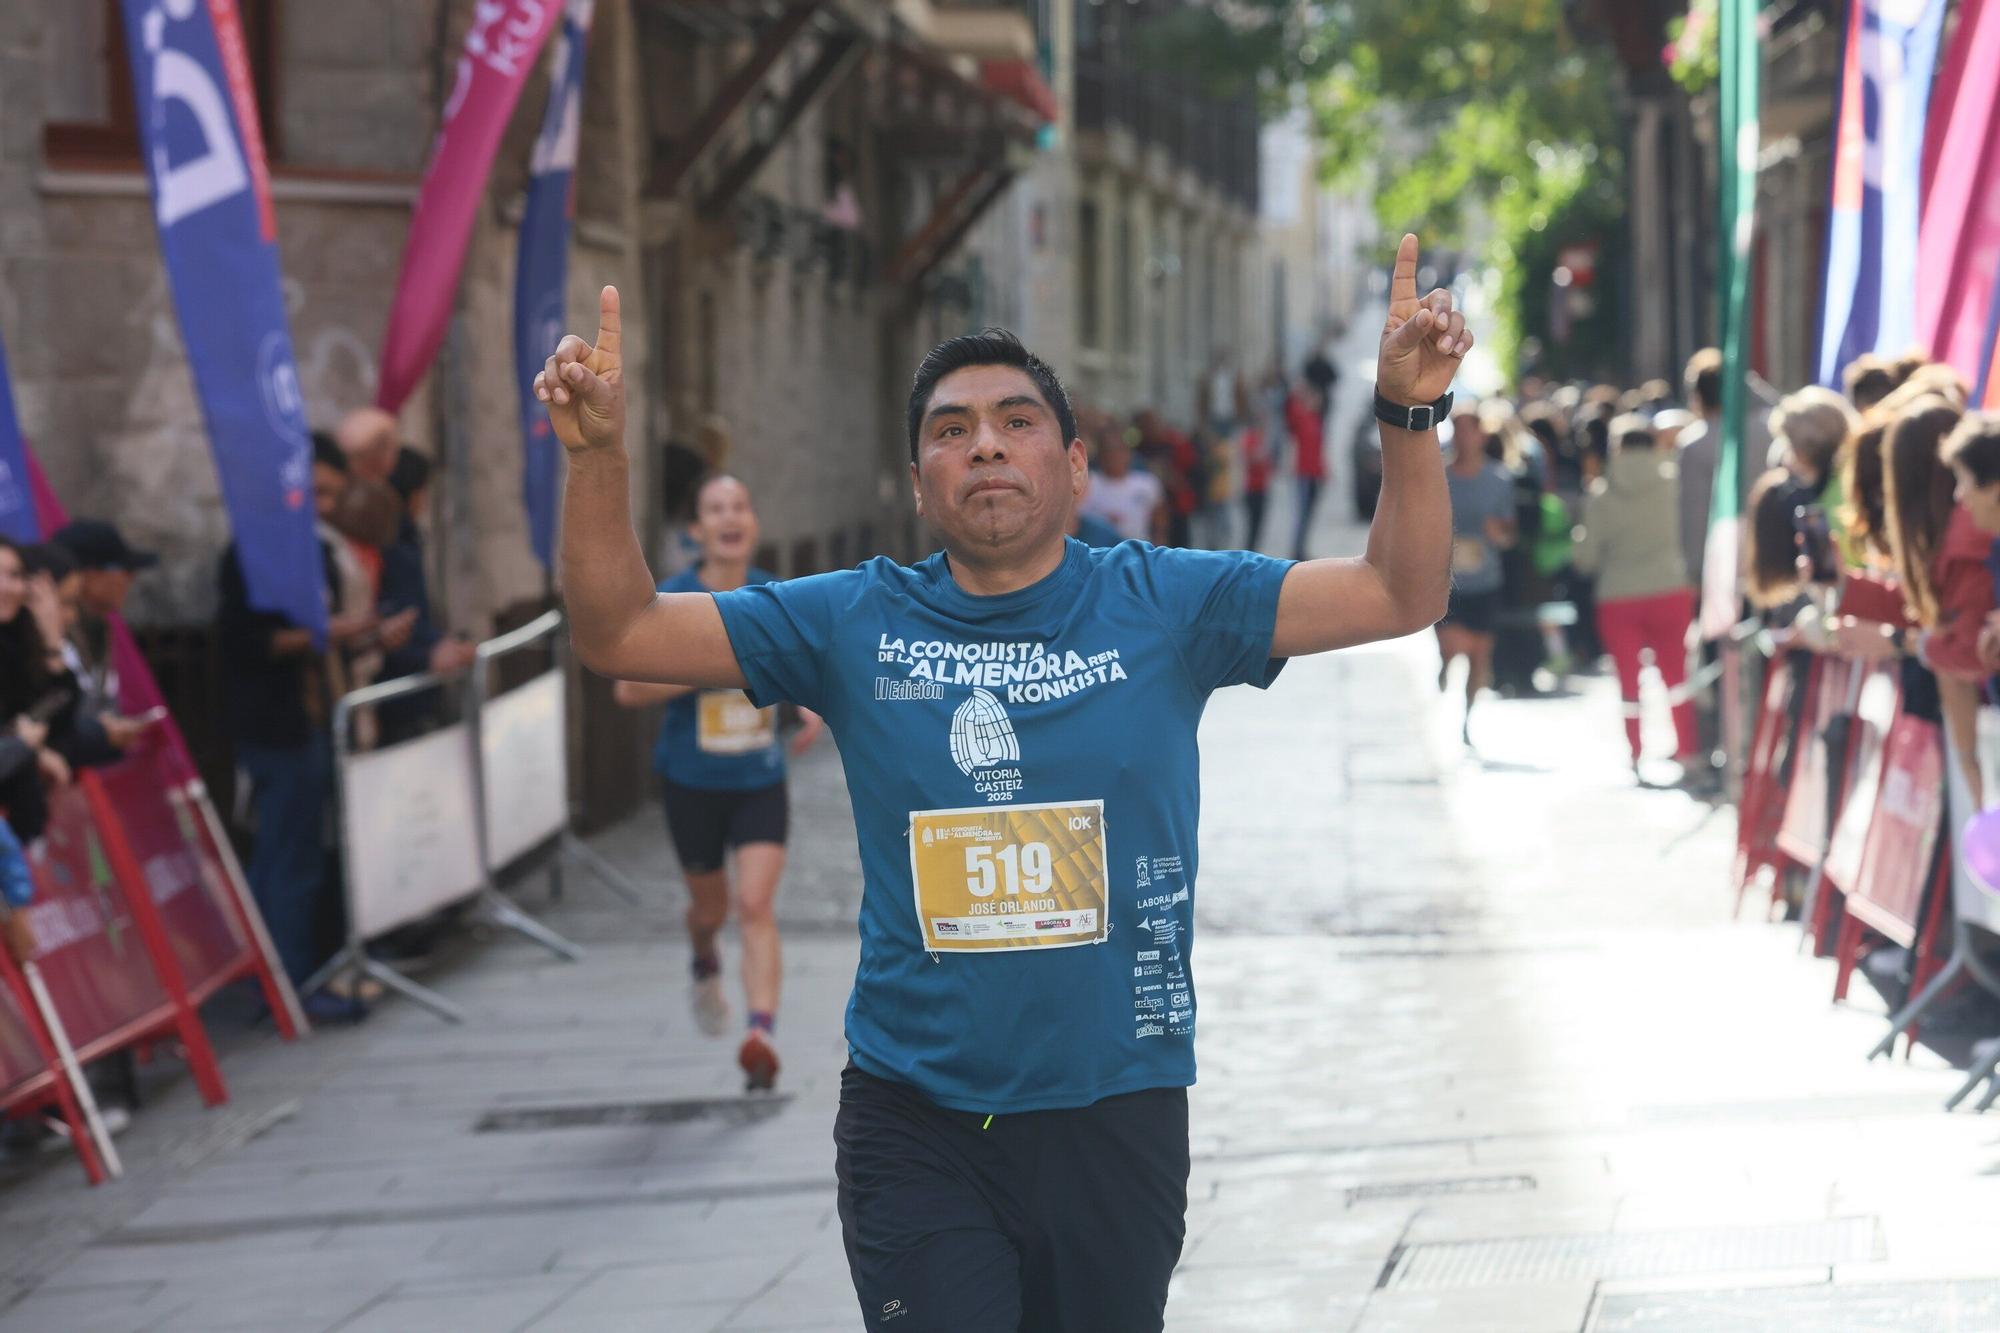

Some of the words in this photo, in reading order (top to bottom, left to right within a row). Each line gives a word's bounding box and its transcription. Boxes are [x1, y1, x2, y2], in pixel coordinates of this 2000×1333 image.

[879, 633, 905, 653] LA
[909, 640, 1045, 664] CONQUISTA
[878, 651, 895, 662] DE
[896, 654, 914, 665] LA
[909, 649, 1088, 687] ALMENDRA
[1087, 649, 1120, 668] REN
[875, 677, 888, 700] II
[889, 679, 944, 700] Edición
[1007, 662, 1128, 704] KONKISTA
[973, 768, 1022, 781] VITORIA
[974, 779, 1023, 793] GASTEIZ
[987, 791, 1013, 801] 2025
[1068, 816, 1092, 831] 10K
[965, 842, 1053, 897] 519
[968, 900, 996, 916] JOSÉ
[1000, 898, 1056, 914] ORLANDO
[1137, 894, 1172, 909] LABORAL
